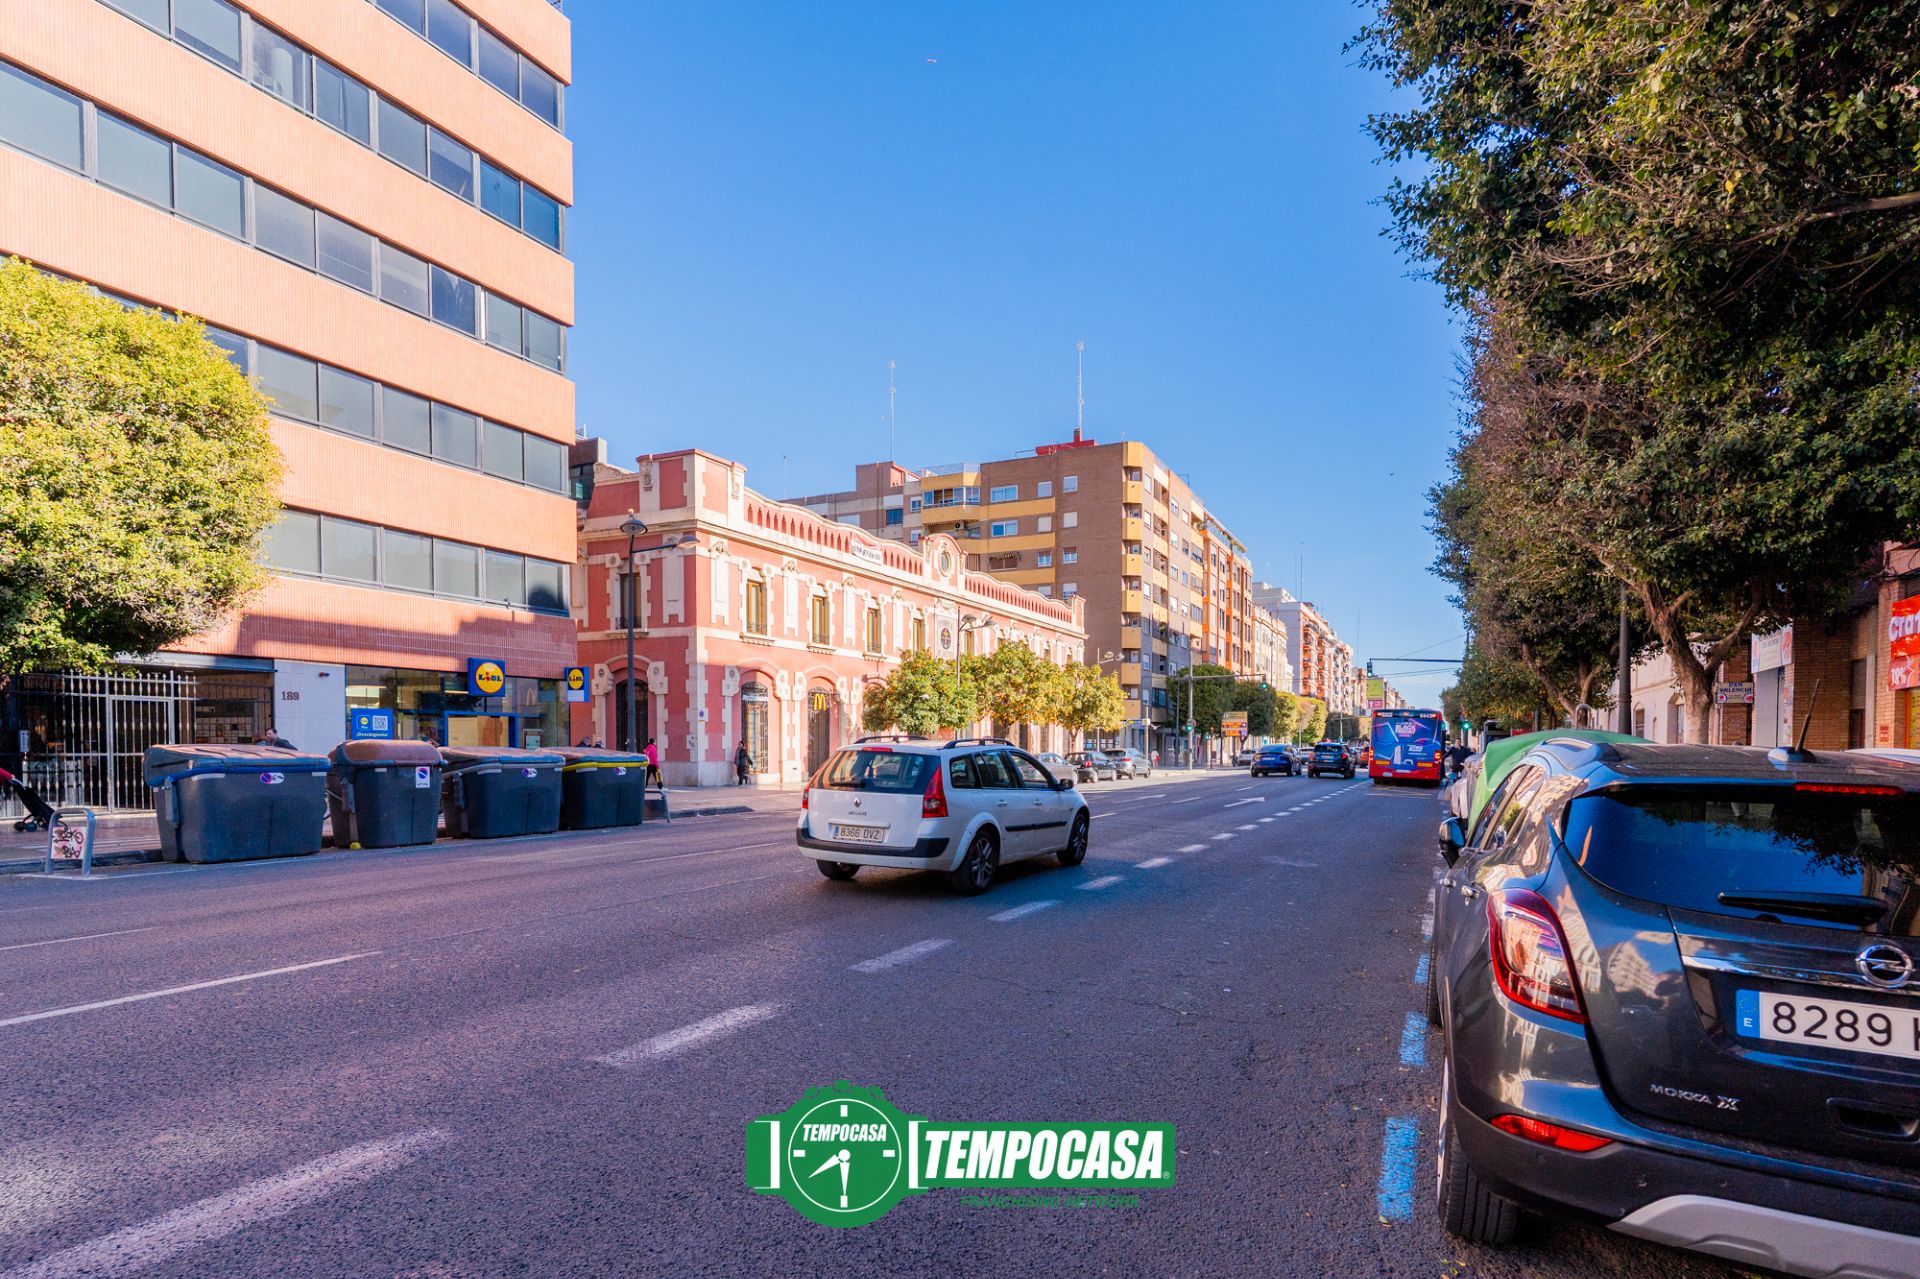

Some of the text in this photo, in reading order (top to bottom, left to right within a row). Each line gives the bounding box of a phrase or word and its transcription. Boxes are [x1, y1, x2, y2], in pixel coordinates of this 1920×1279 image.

[281, 690, 300, 701] 189
[863, 828, 880, 840] DVZ
[1743, 1017, 1753, 1028] E
[1772, 1001, 1892, 1047] 8289
[1650, 1084, 1713, 1104] MOKKA
